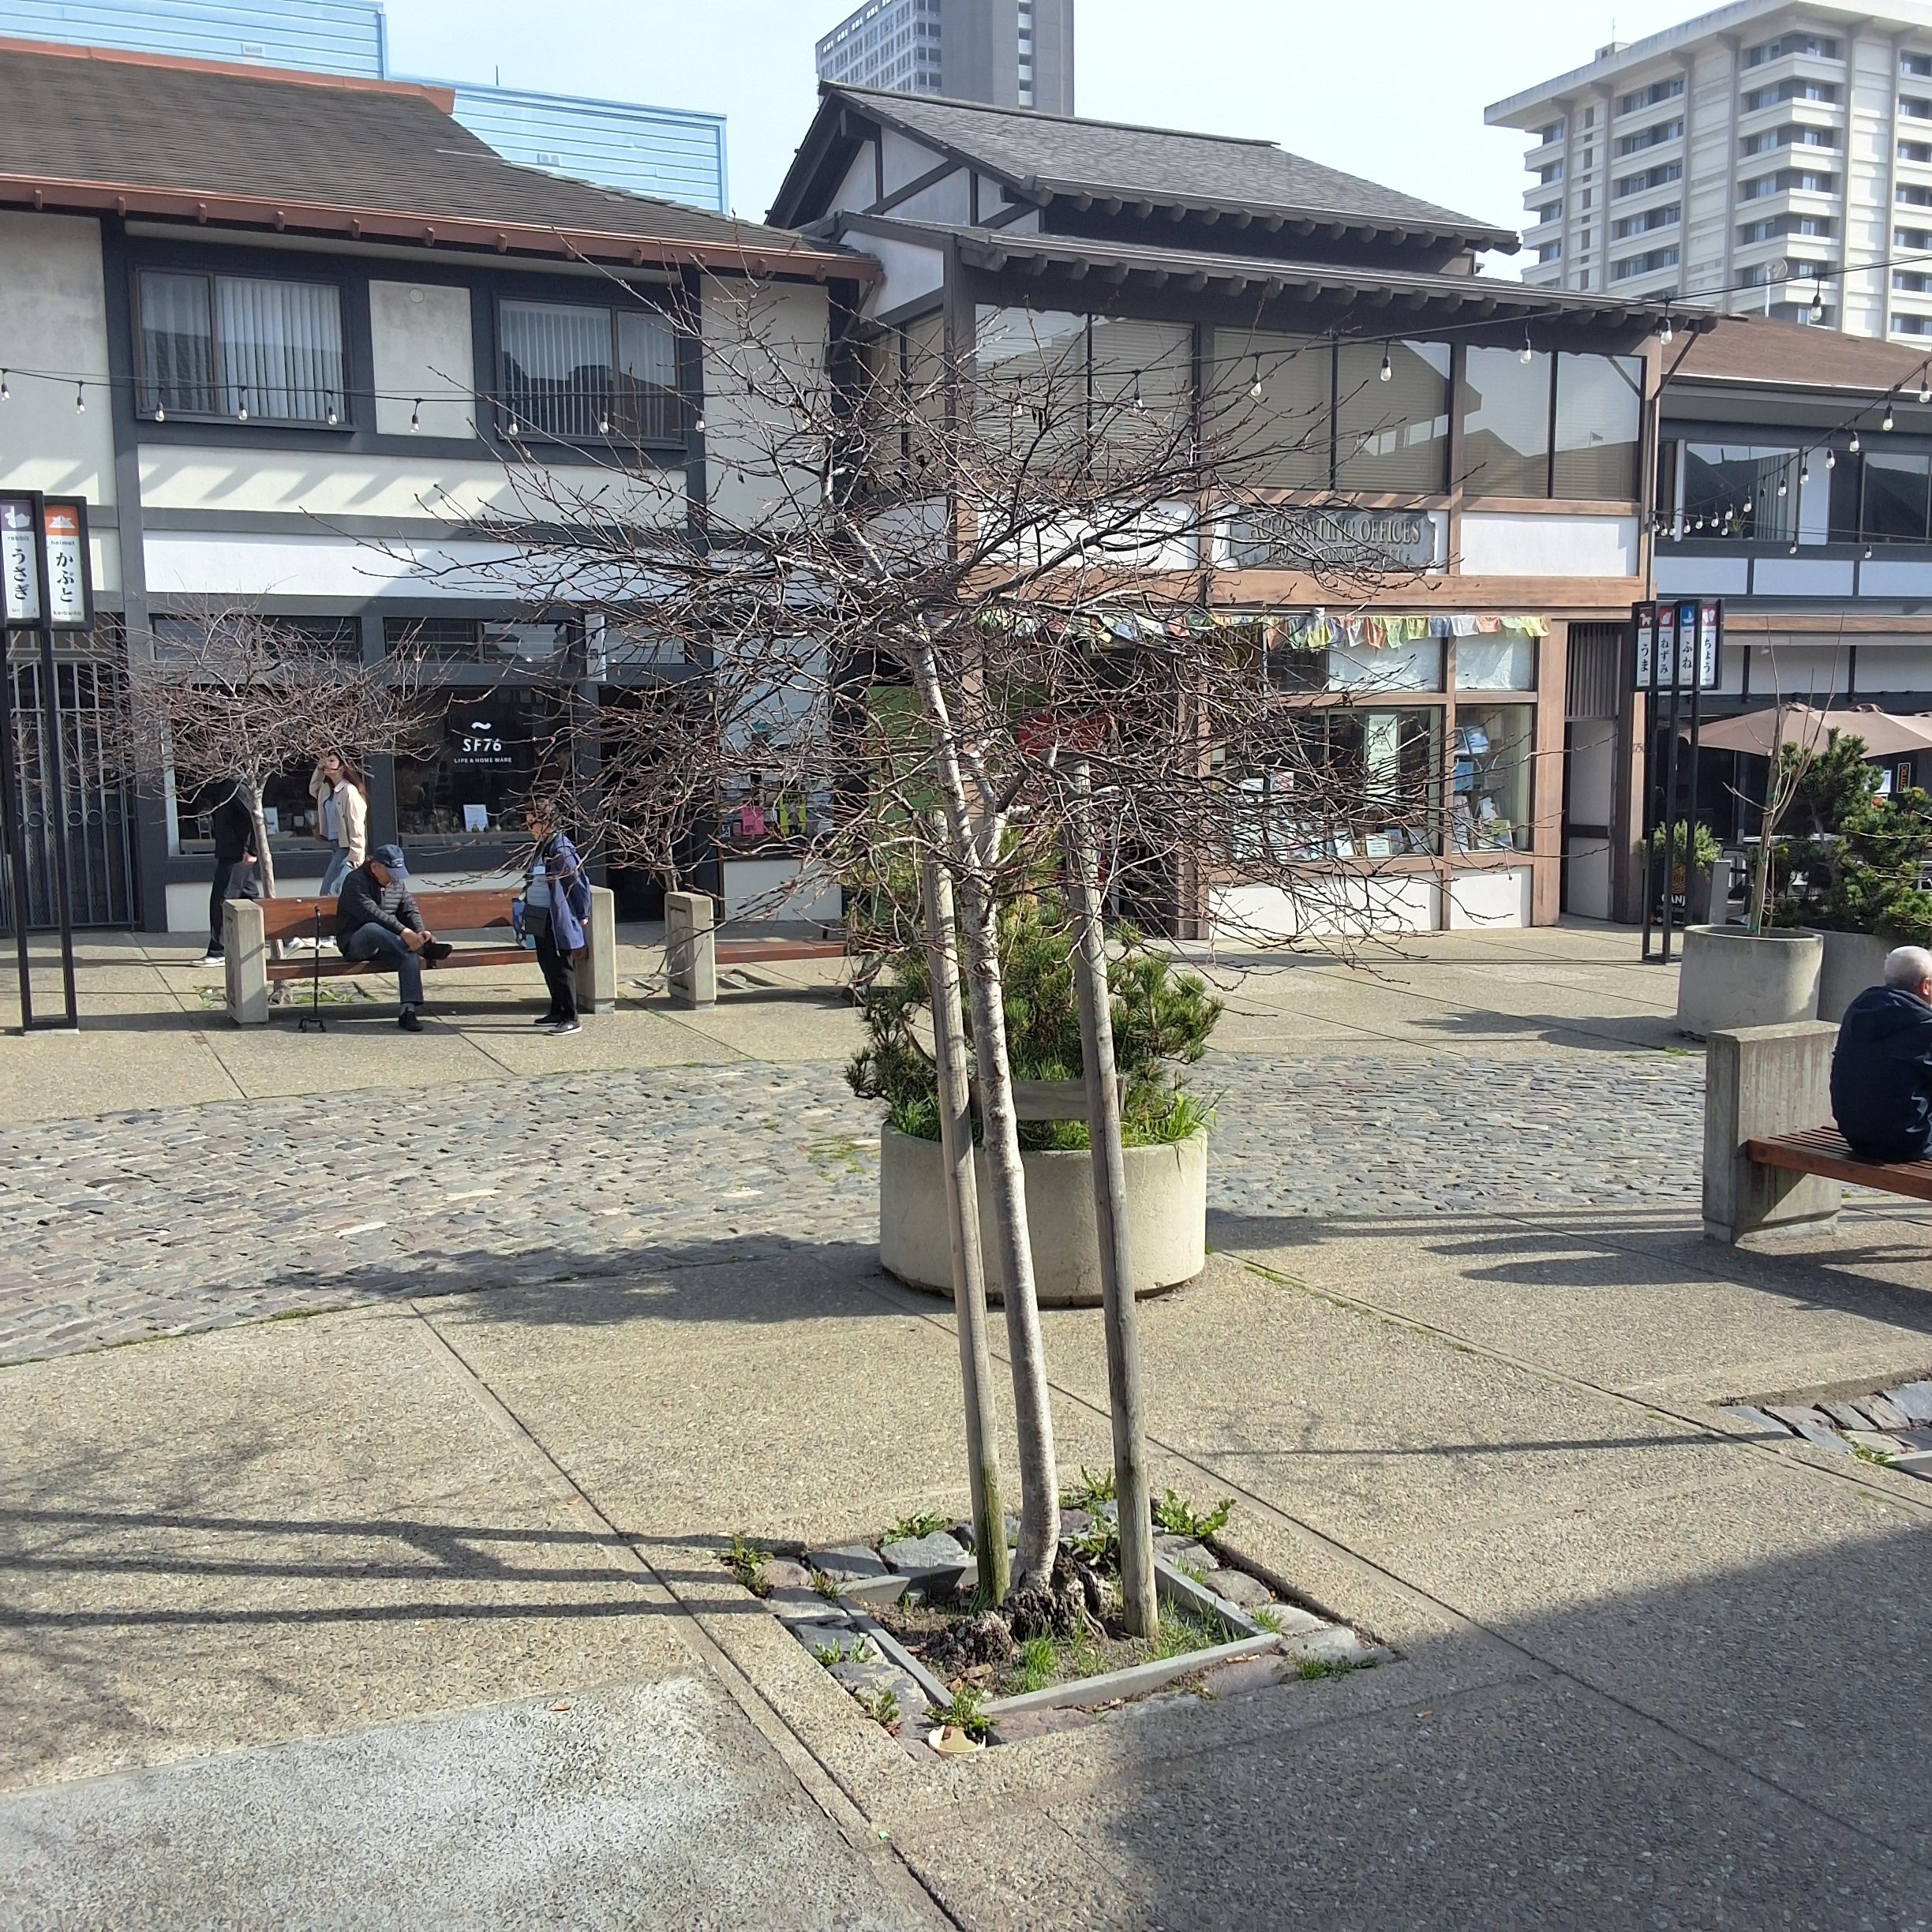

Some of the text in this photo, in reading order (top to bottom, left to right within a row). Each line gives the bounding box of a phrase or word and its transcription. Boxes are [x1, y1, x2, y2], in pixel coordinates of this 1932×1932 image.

[1359, 519, 1421, 544] OFFICES
[11, 548, 31, 601] うさぎ
[55, 552, 75, 603] かぶと
[1641, 643, 1649, 672] うま
[1660, 637, 1669, 674] ねずみ
[1683, 642, 1692, 669] ふね
[1703, 638, 1712, 673] ちょう
[462, 738, 502, 752] SF76
